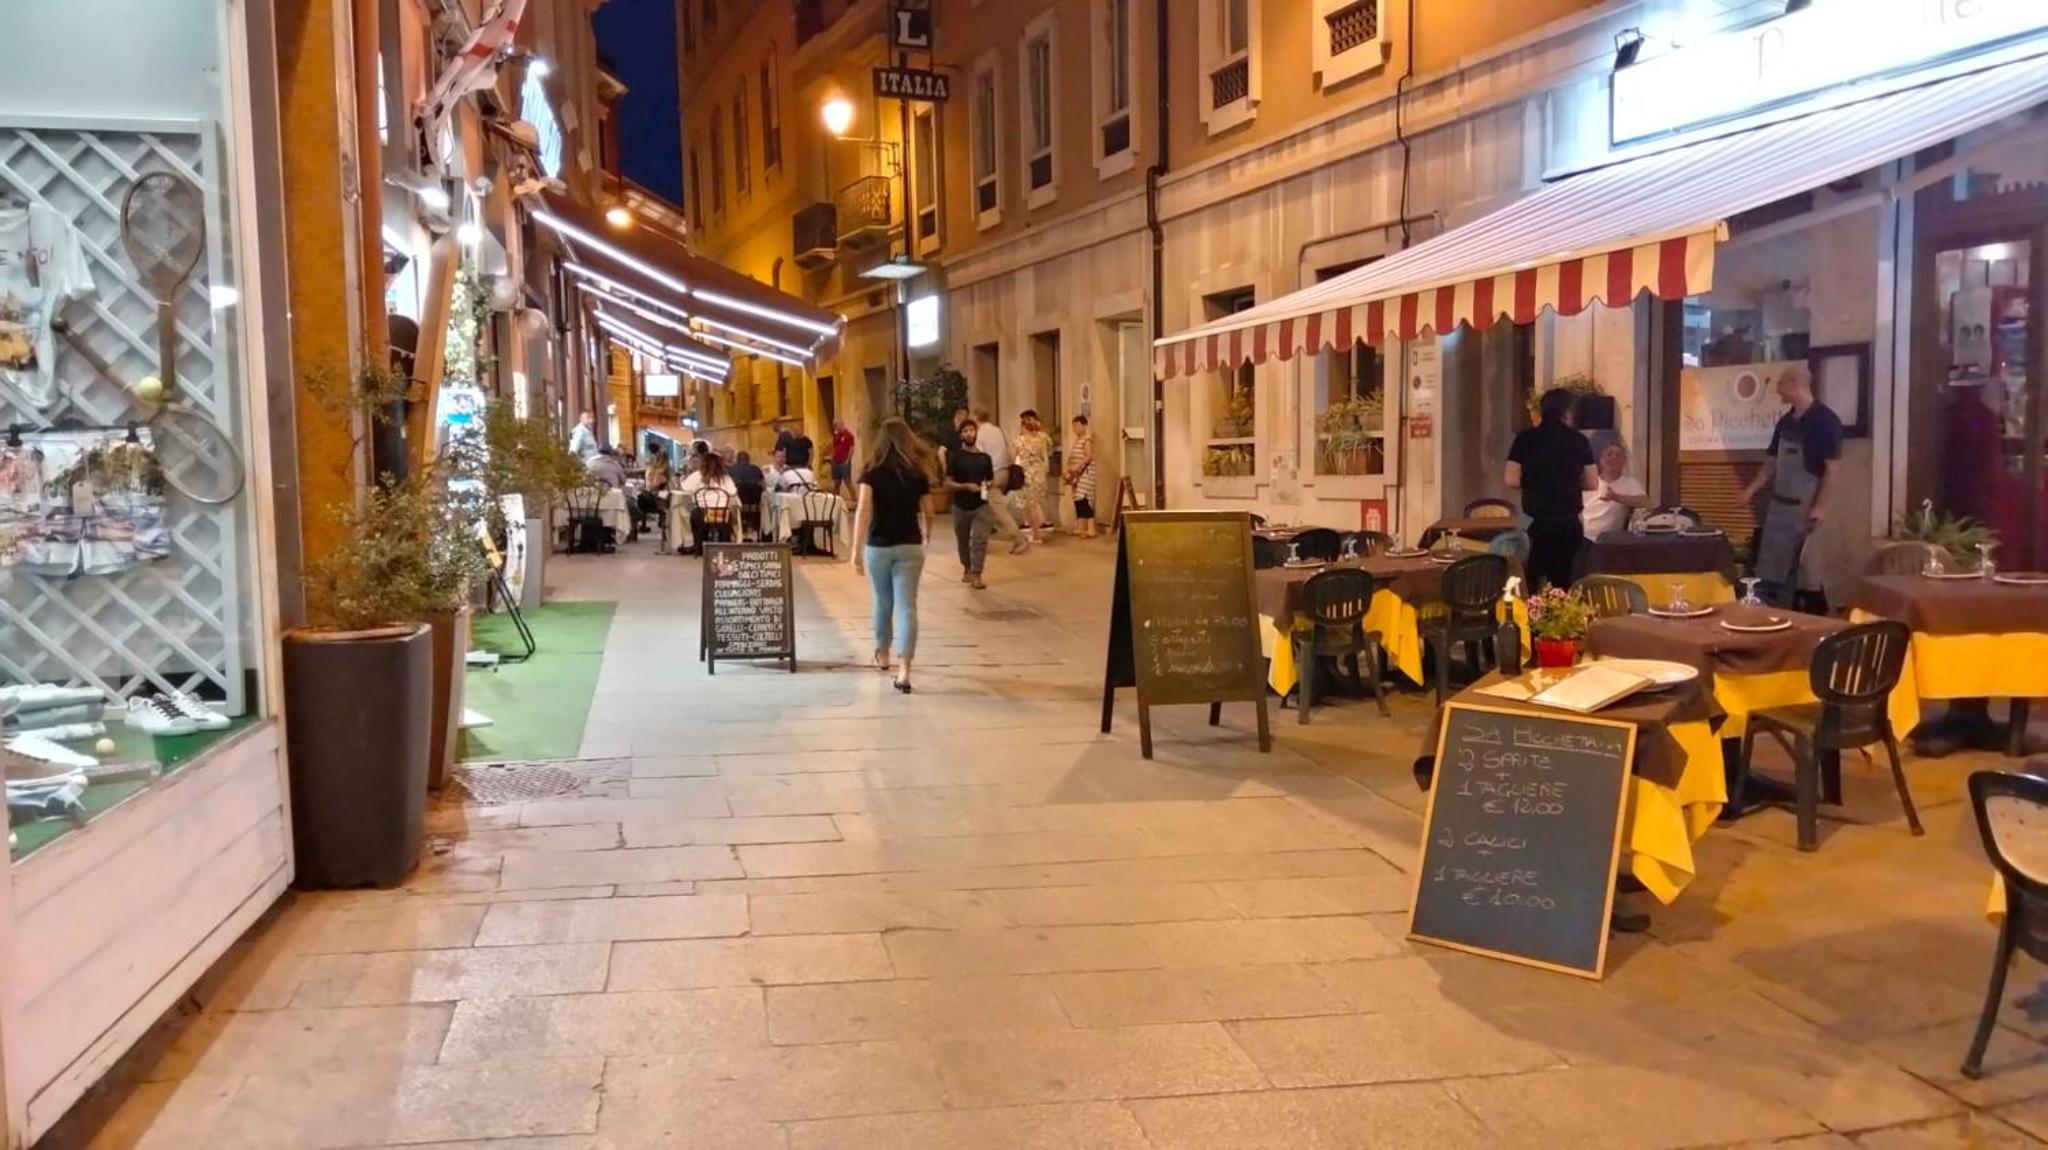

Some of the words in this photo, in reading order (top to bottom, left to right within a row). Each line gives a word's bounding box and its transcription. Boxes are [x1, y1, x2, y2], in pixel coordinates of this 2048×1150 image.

[897, 12, 928, 46] L
[880, 71, 948, 98] ITALIA
[1458, 748, 1474, 772] 2
[1482, 750, 1553, 770] SPRITZ
[1457, 779, 1473, 796] 1
[1475, 781, 1568, 798] TAGLIERE
[1482, 799, 1505, 815] €
[1437, 827, 1454, 848] 2
[1464, 832, 1527, 850] CALICI
[1434, 865, 1447, 882] 1
[1462, 887, 1487, 906] €
